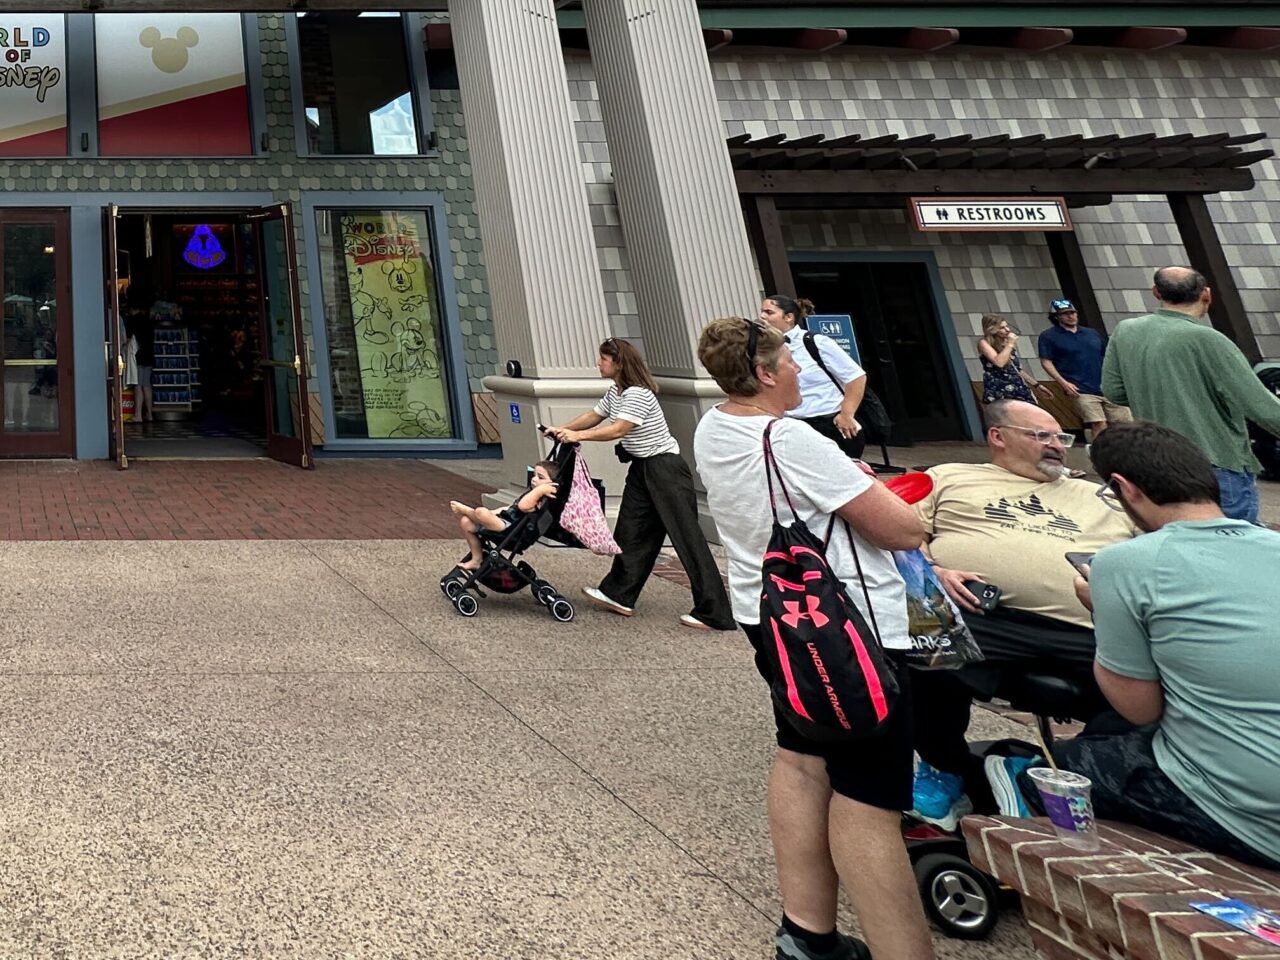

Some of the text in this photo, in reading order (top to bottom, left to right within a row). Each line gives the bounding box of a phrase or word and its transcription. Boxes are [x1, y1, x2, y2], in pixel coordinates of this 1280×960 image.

[5, 49, 31, 63] OF
[957, 208, 1046, 220] RESTROOMS
[343, 233, 415, 264] Disney
[806, 642, 852, 730] UNDER ARMOUR
